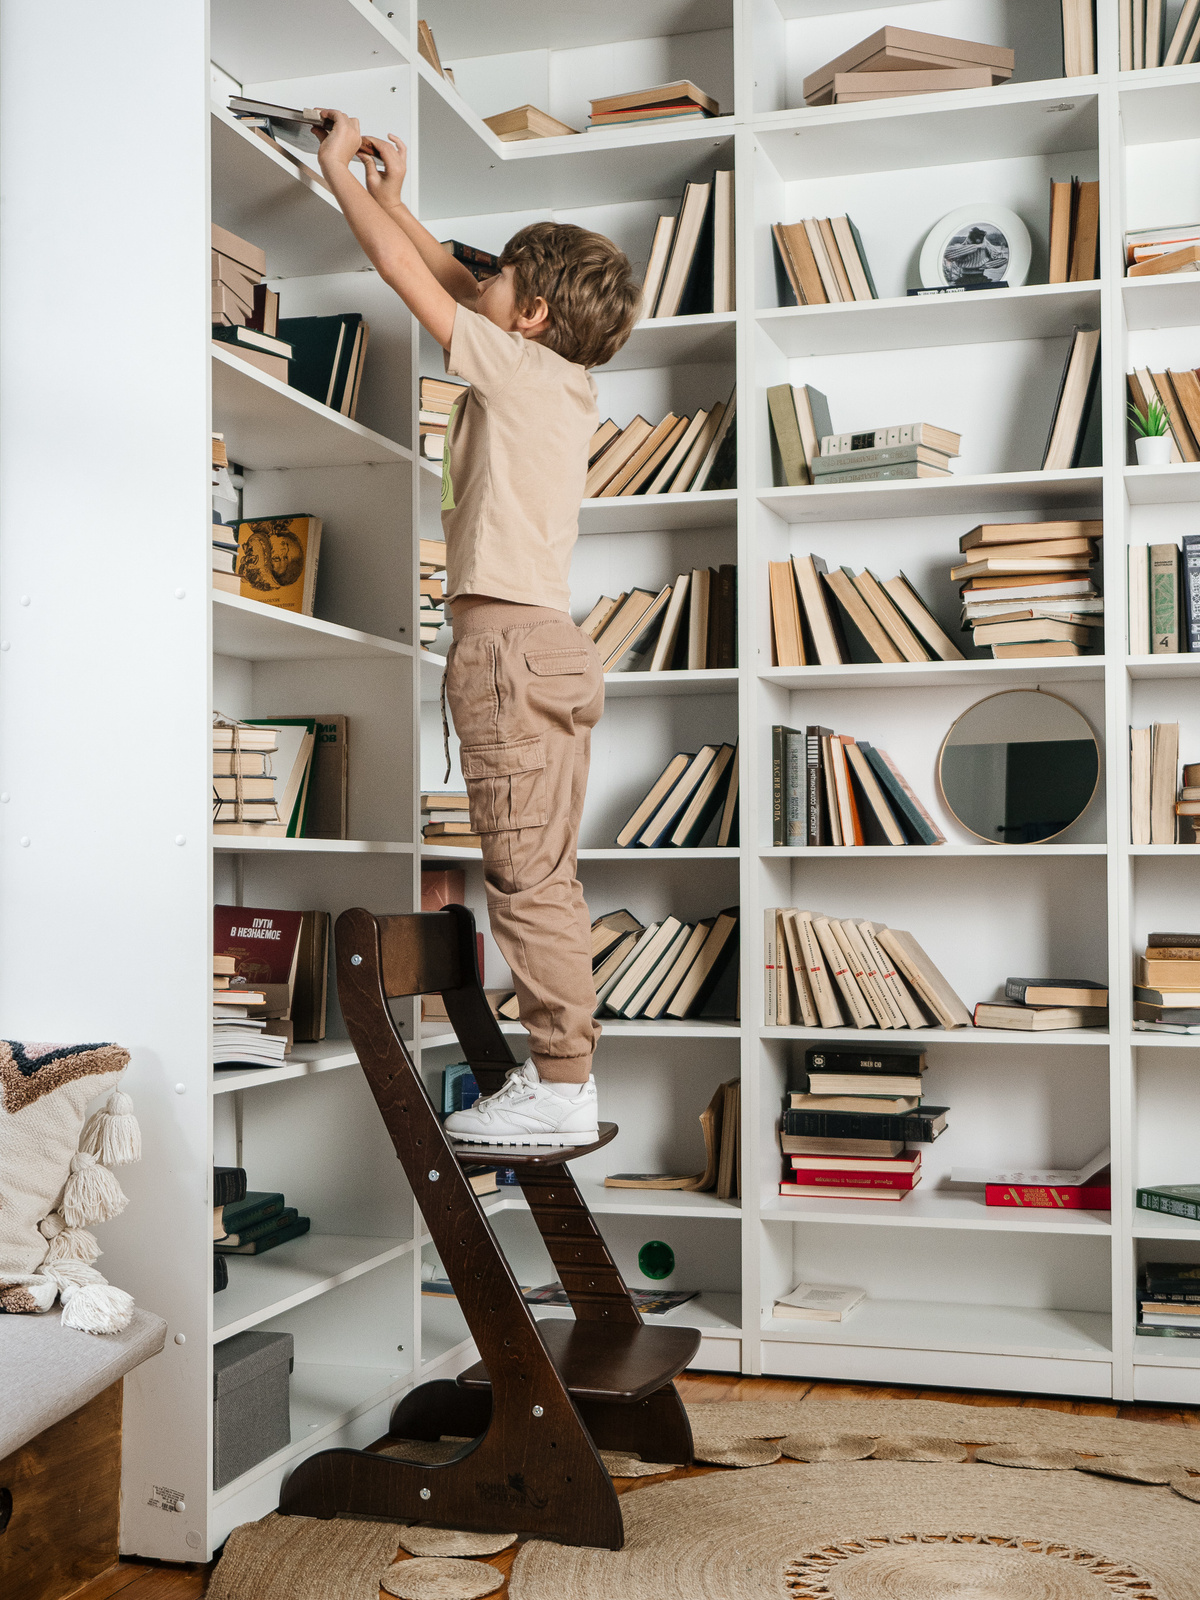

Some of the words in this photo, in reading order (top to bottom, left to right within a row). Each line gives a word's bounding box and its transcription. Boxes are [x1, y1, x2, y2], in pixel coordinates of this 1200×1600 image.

[1159, 635, 1169, 648] 4
[773, 759, 781, 789] БАСНИ
[809, 768, 817, 805] СОЛЖЕНИЦЫН
[773, 792, 781, 822] ЭЗОПА
[809, 806, 817, 836] АЛЕКСАНДР
[230, 927, 237, 937] В
[237, 927, 282, 940] НЕЗНАЕМОЕ
[252, 918, 273, 929] ПУТИ
